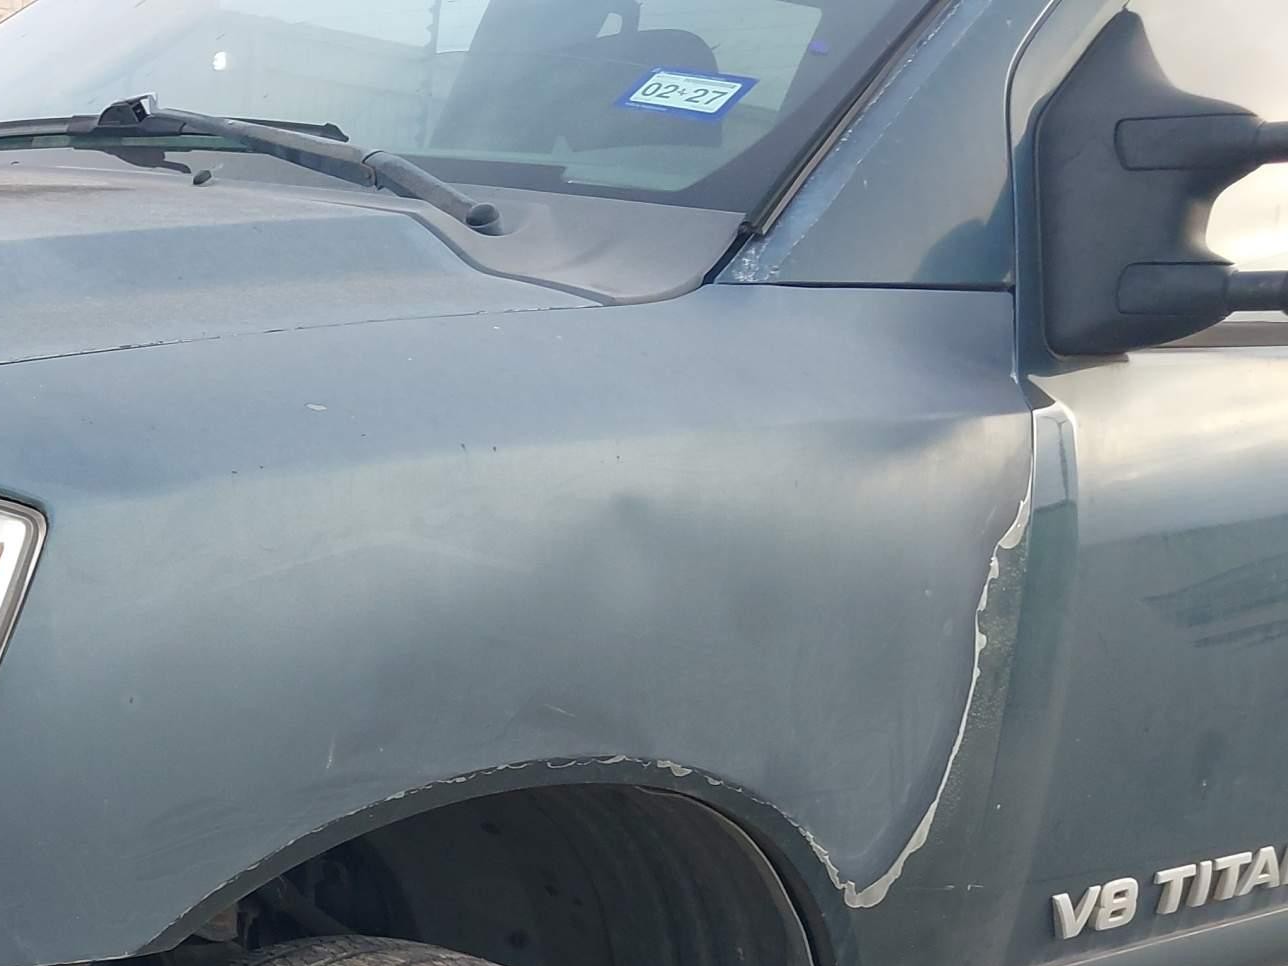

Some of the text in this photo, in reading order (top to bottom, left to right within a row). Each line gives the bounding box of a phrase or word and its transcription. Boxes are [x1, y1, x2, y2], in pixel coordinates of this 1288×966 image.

[641, 82, 728, 105] 02 27
[1052, 845, 1288, 940] V8 TITA
